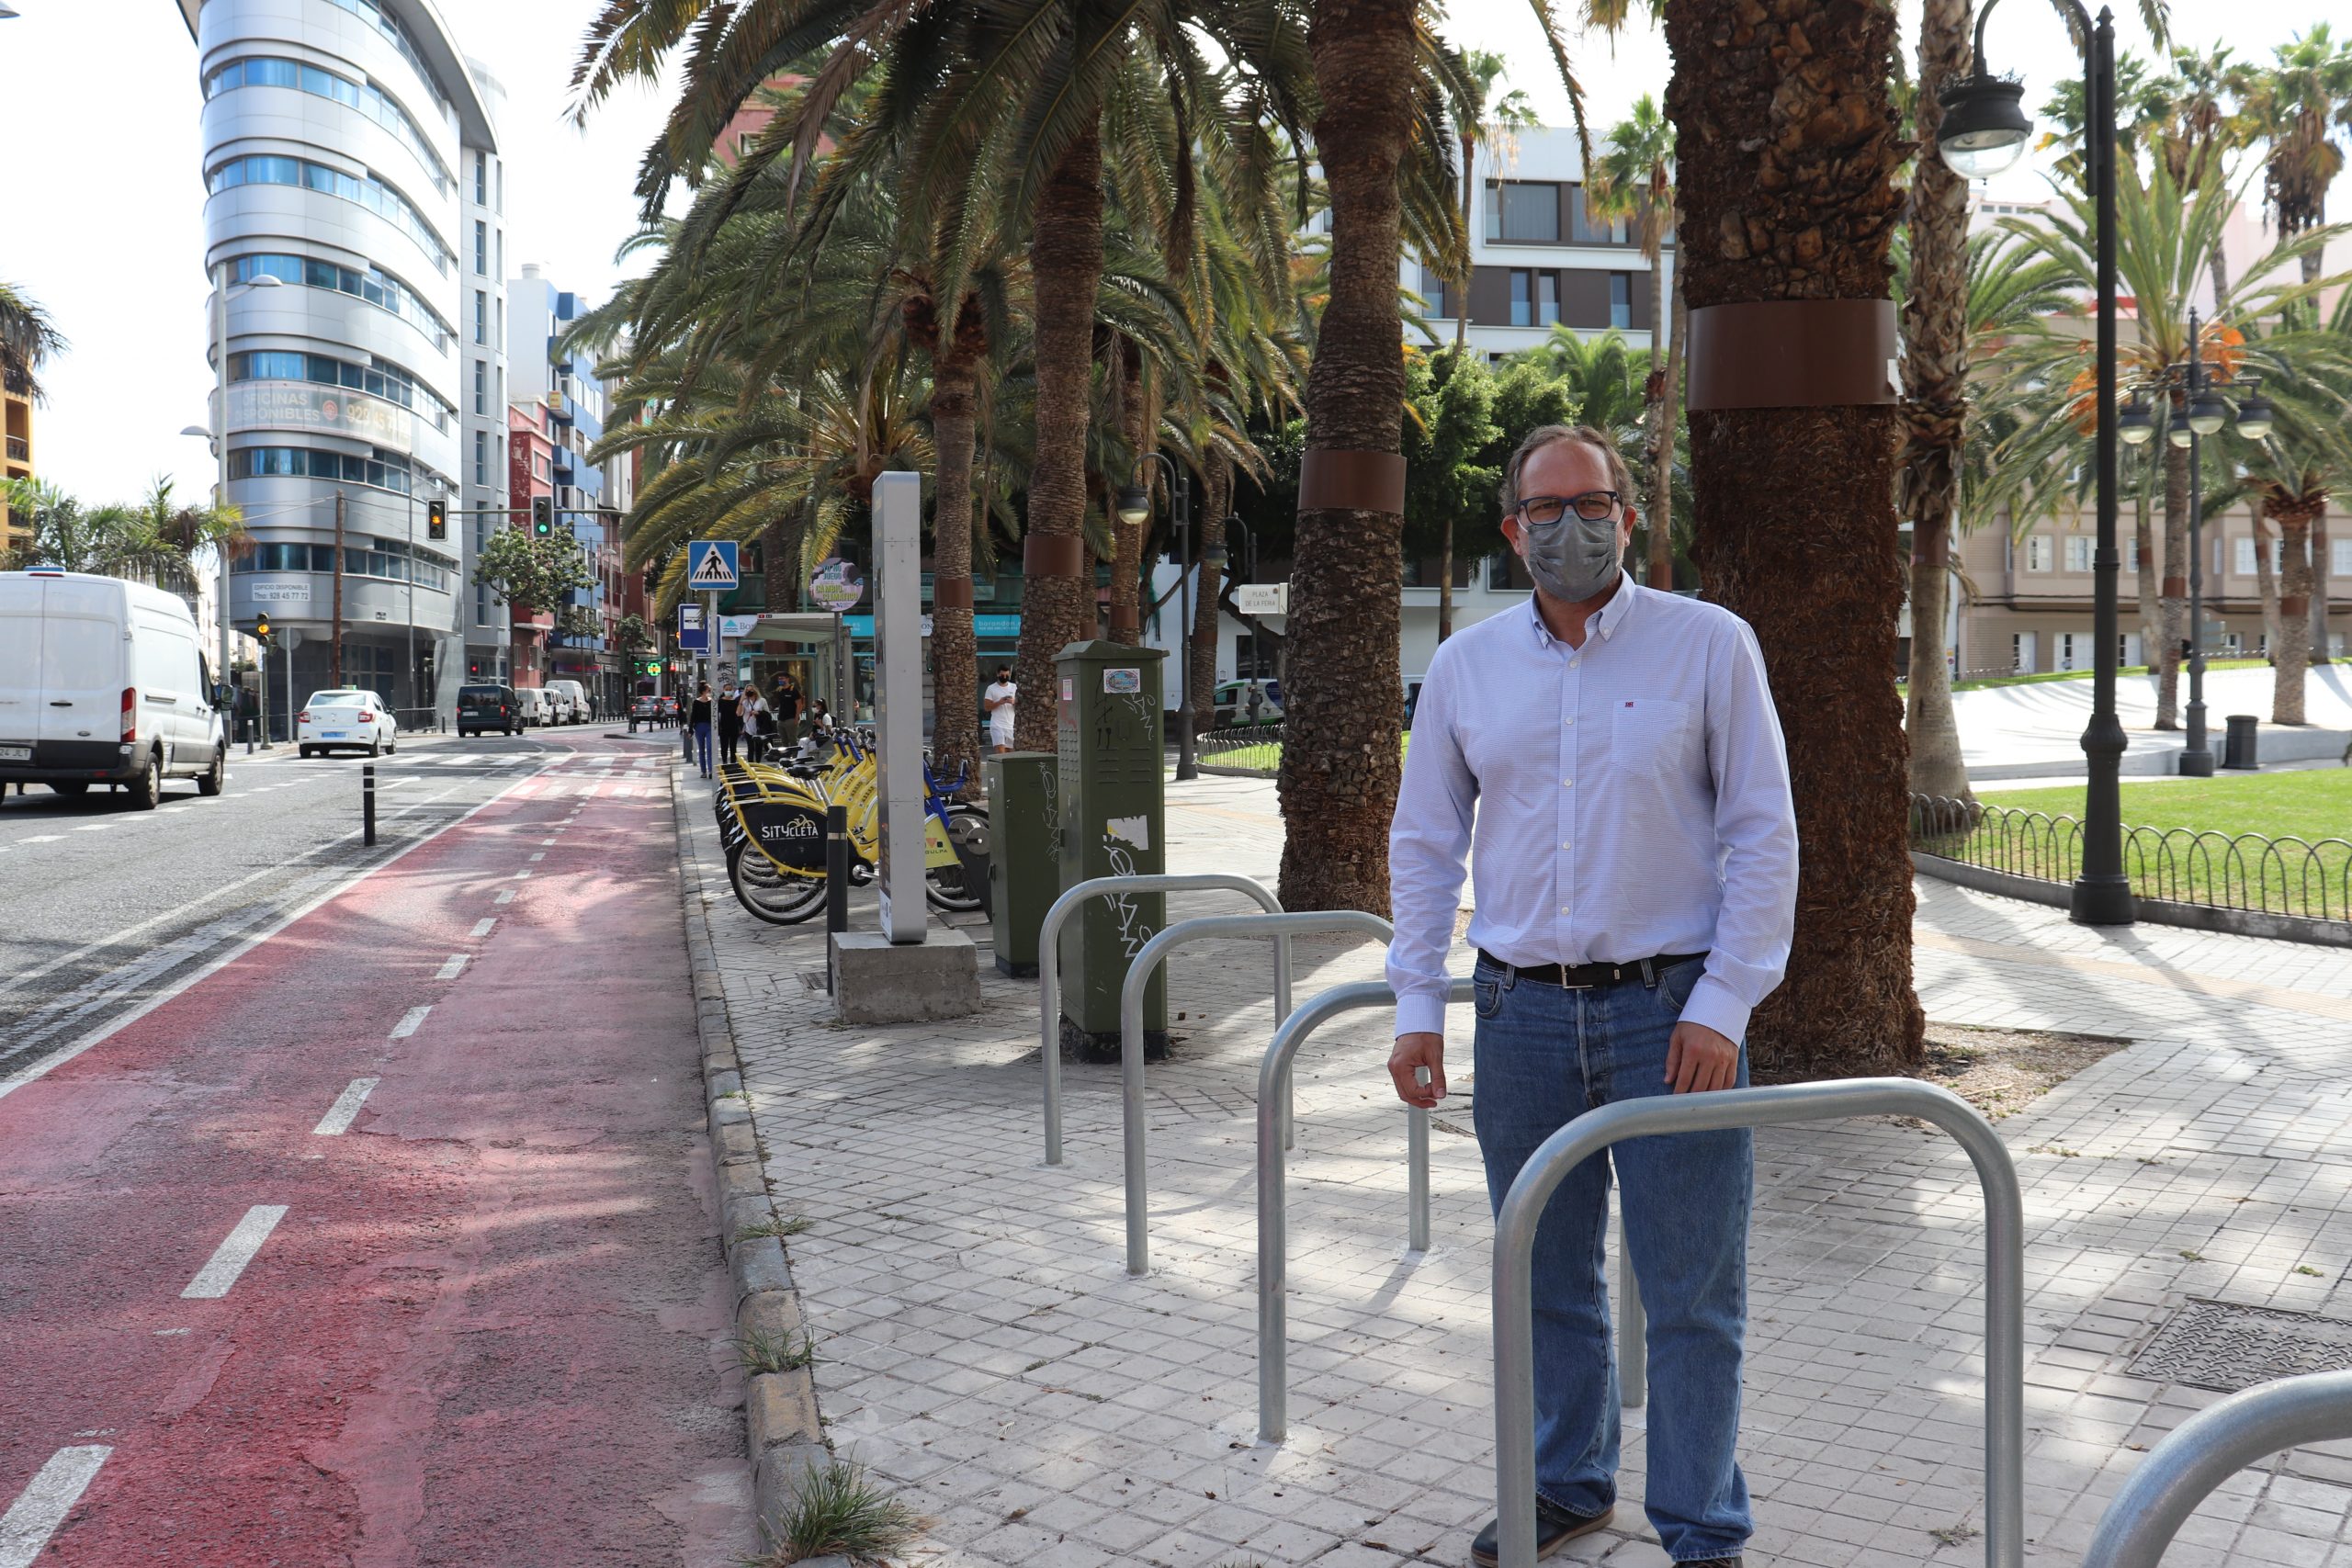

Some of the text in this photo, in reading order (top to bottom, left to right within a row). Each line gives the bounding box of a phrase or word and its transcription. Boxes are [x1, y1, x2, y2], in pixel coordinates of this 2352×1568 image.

[243, 393, 309, 406] OFICINAS
[270, 592, 280, 600] 928
[281, 592, 290, 600] 45
[291, 592, 300, 600] 77
[301, 592, 309, 600] 72
